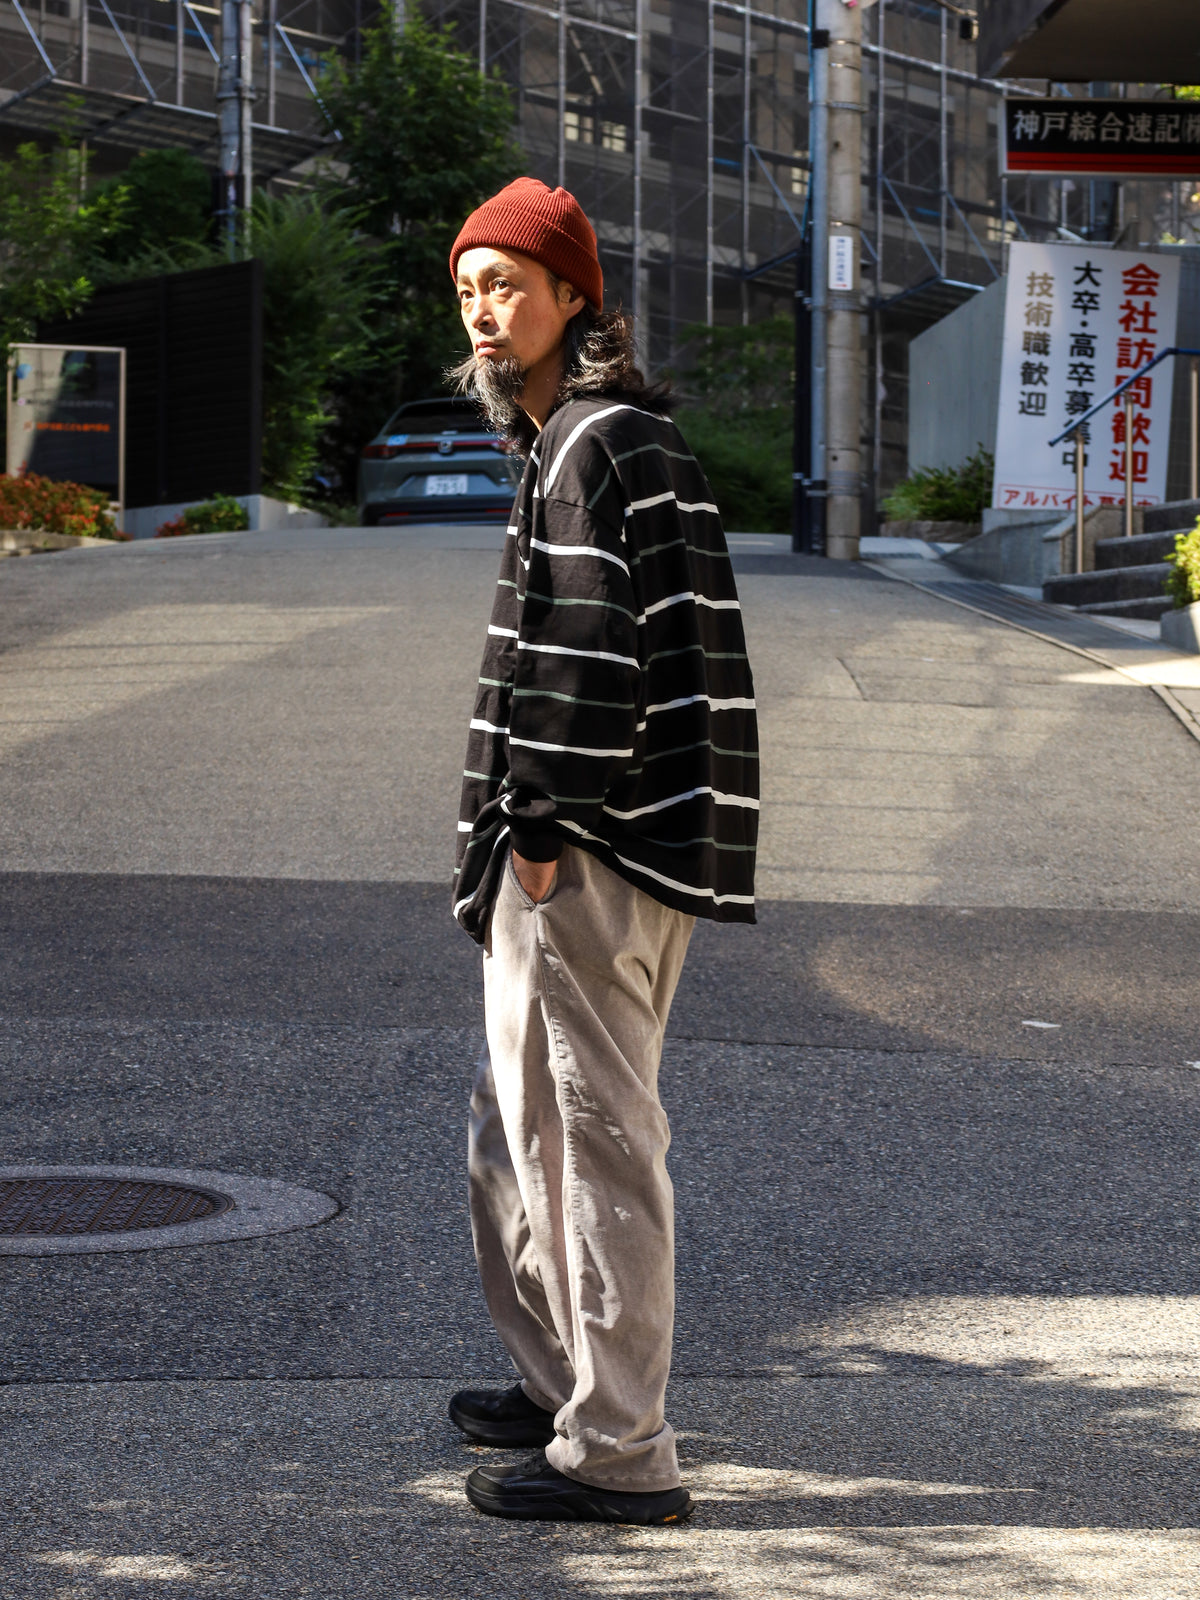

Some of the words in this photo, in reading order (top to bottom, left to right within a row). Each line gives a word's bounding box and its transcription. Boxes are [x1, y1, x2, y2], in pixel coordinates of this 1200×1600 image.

[1018, 271, 1055, 416] 技術職歓迎
[1109, 262, 1161, 483] 会社訪問歓迎
